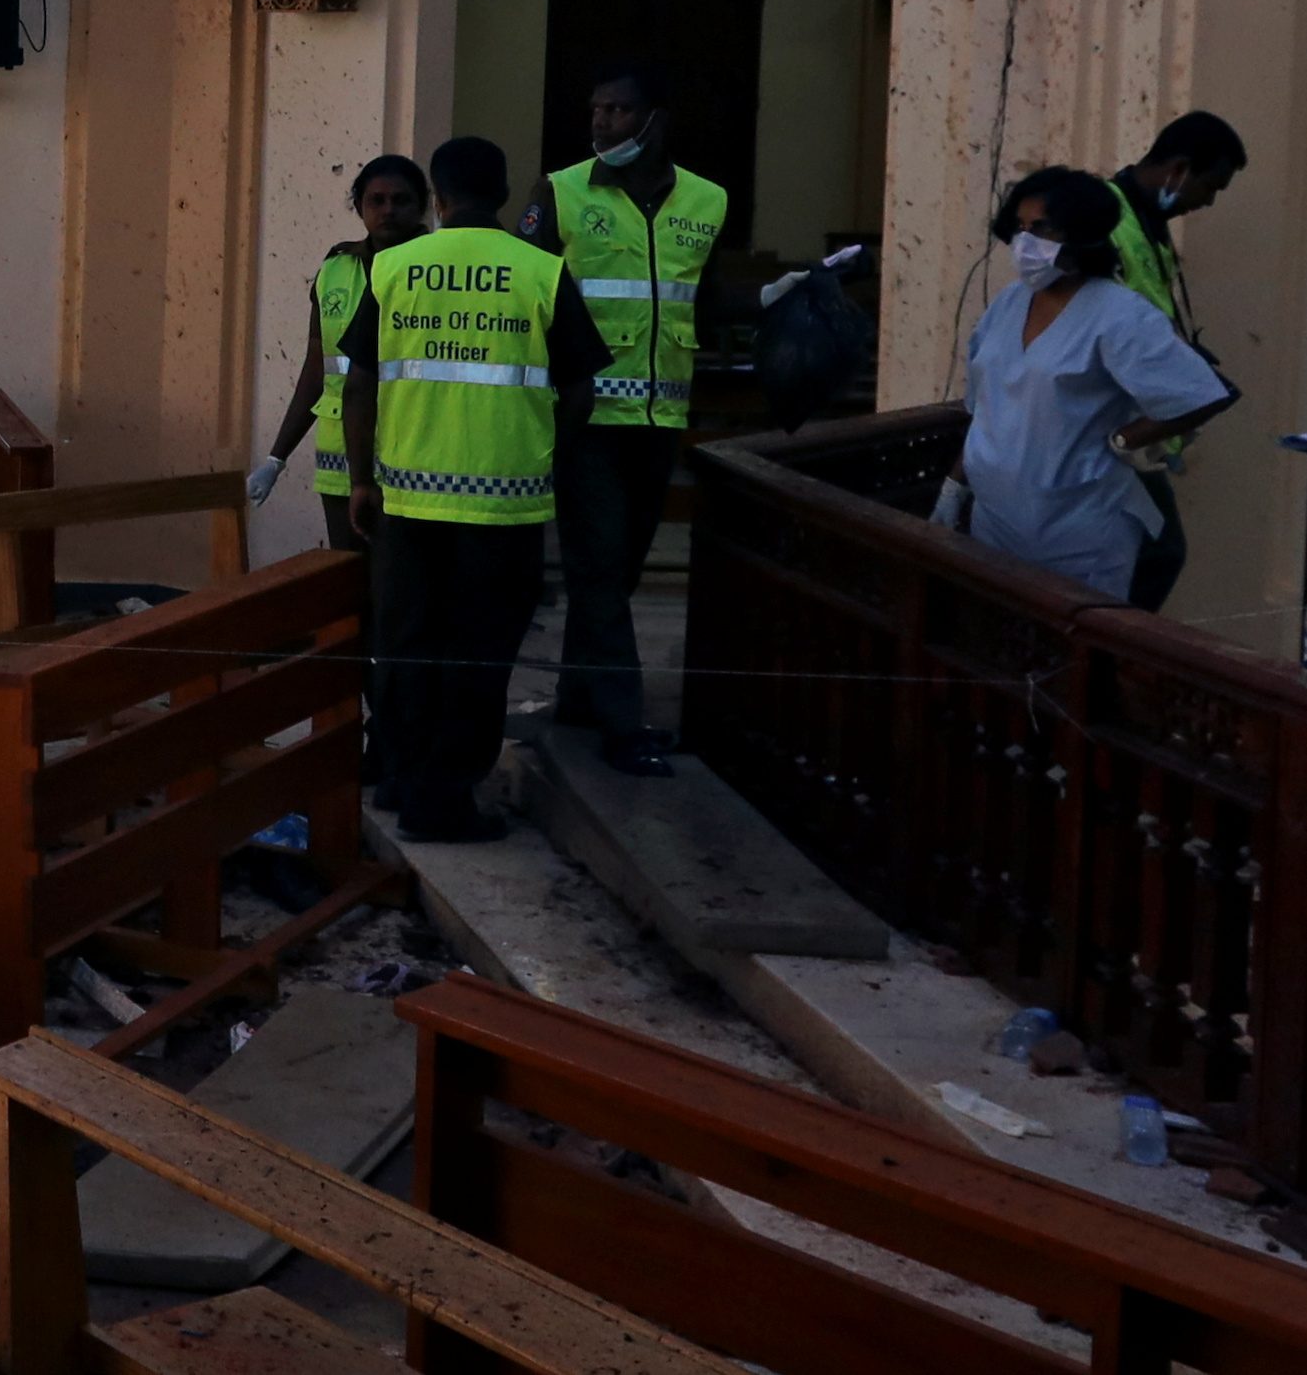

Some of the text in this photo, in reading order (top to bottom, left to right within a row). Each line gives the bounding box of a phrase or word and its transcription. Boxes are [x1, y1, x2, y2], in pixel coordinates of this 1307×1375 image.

[669, 217, 717, 237] POLICE
[407, 264, 512, 292] POLICE
[392, 311, 531, 333] Scene Of Crime
[425, 340, 490, 361] Officer
